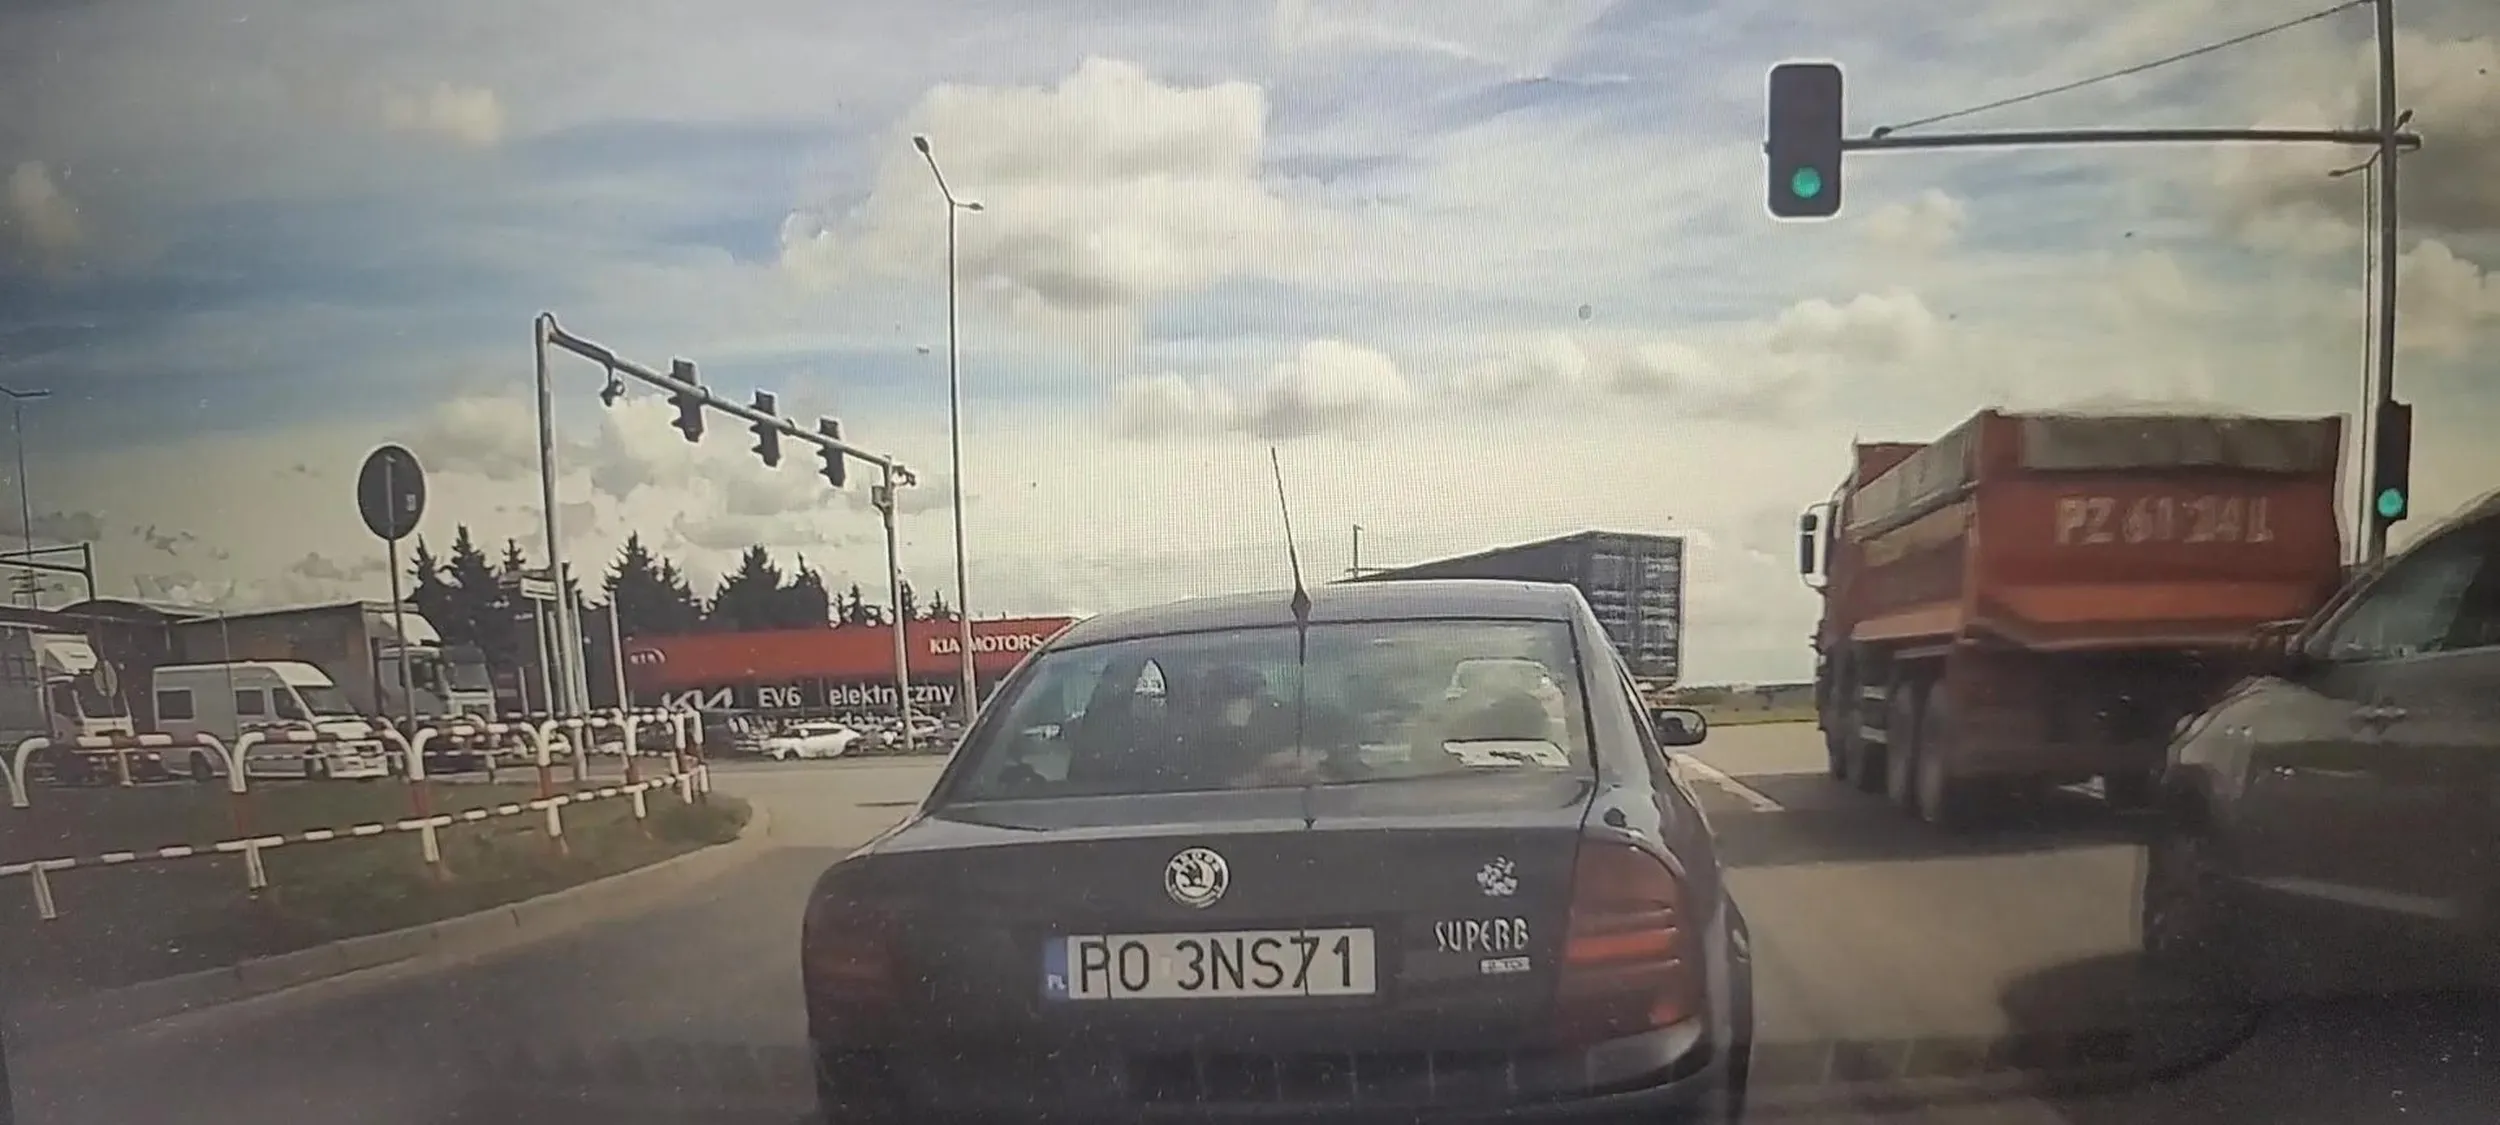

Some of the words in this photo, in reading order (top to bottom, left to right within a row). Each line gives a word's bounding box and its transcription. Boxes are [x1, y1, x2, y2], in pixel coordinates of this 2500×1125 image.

[929, 638, 960, 654] KIA
[969, 634, 1044, 652] MOTORS
[758, 686, 801, 708] EV6
[1435, 917, 1529, 952] SUPERB
[1080, 941, 1150, 993] PO
[1175, 935, 1351, 991] 3NS71
